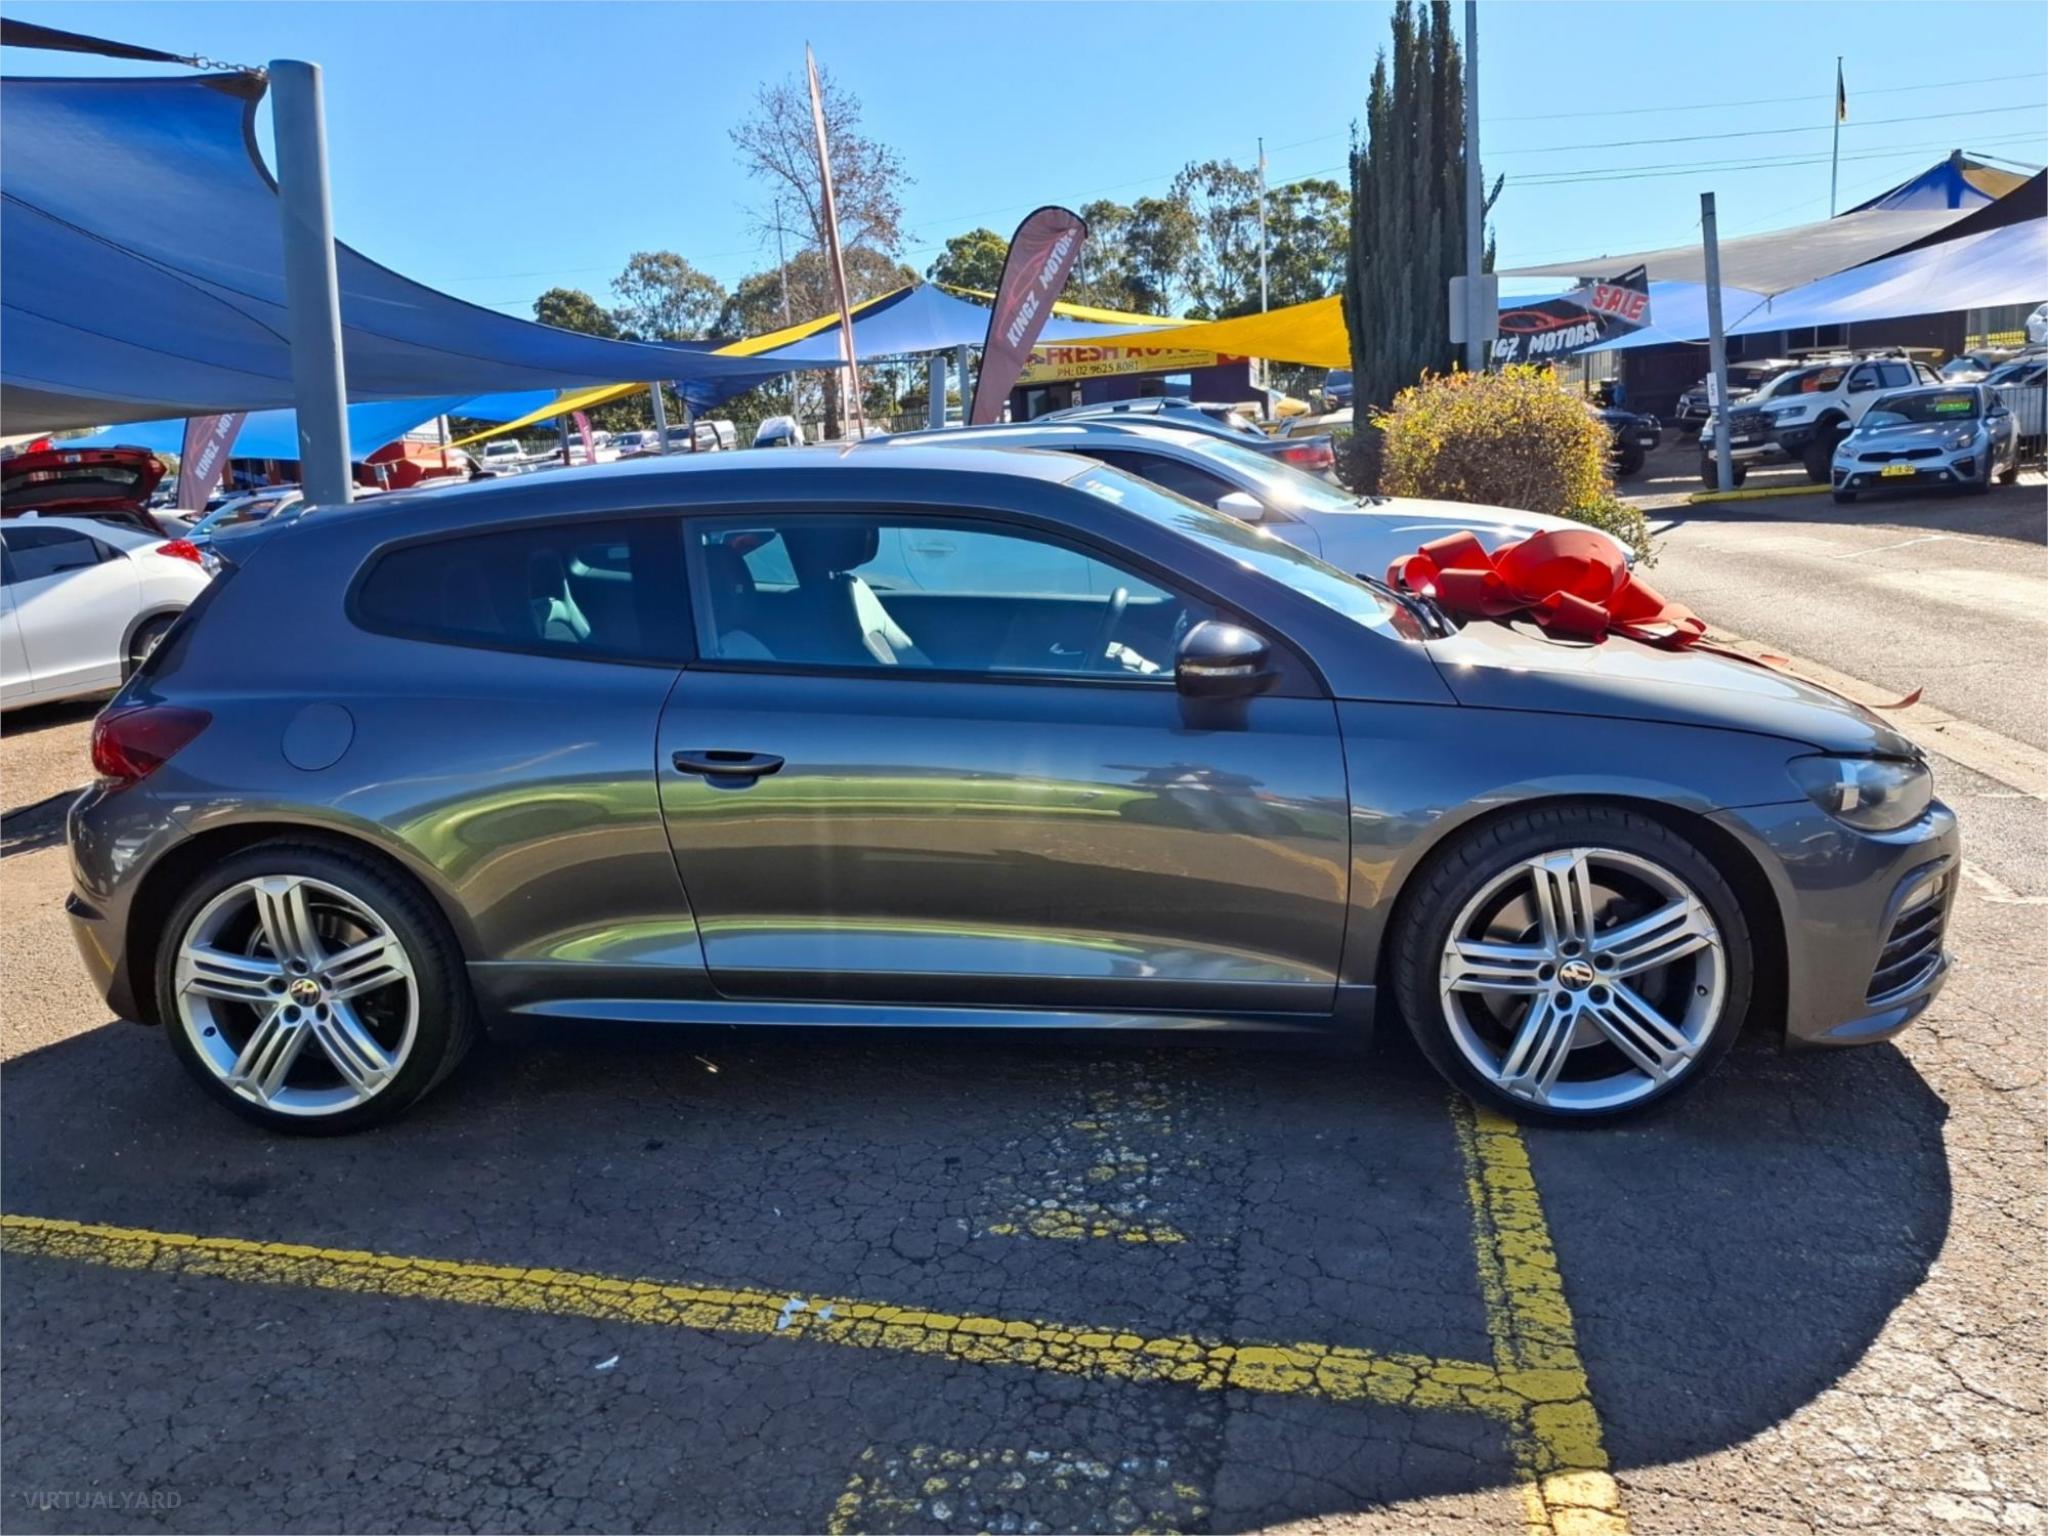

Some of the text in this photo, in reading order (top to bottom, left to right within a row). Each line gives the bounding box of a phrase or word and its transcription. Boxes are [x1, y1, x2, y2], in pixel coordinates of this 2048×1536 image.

[1007, 290, 1039, 347] KINGZ
[1592, 285, 1649, 320] SALE
[1529, 322, 1597, 354] MOTORS
[1046, 345, 1119, 366] FRESH
[1056, 368, 1074, 377] PH:
[1075, 366, 1088, 376] 02
[194, 439, 220, 480] KINGZ
